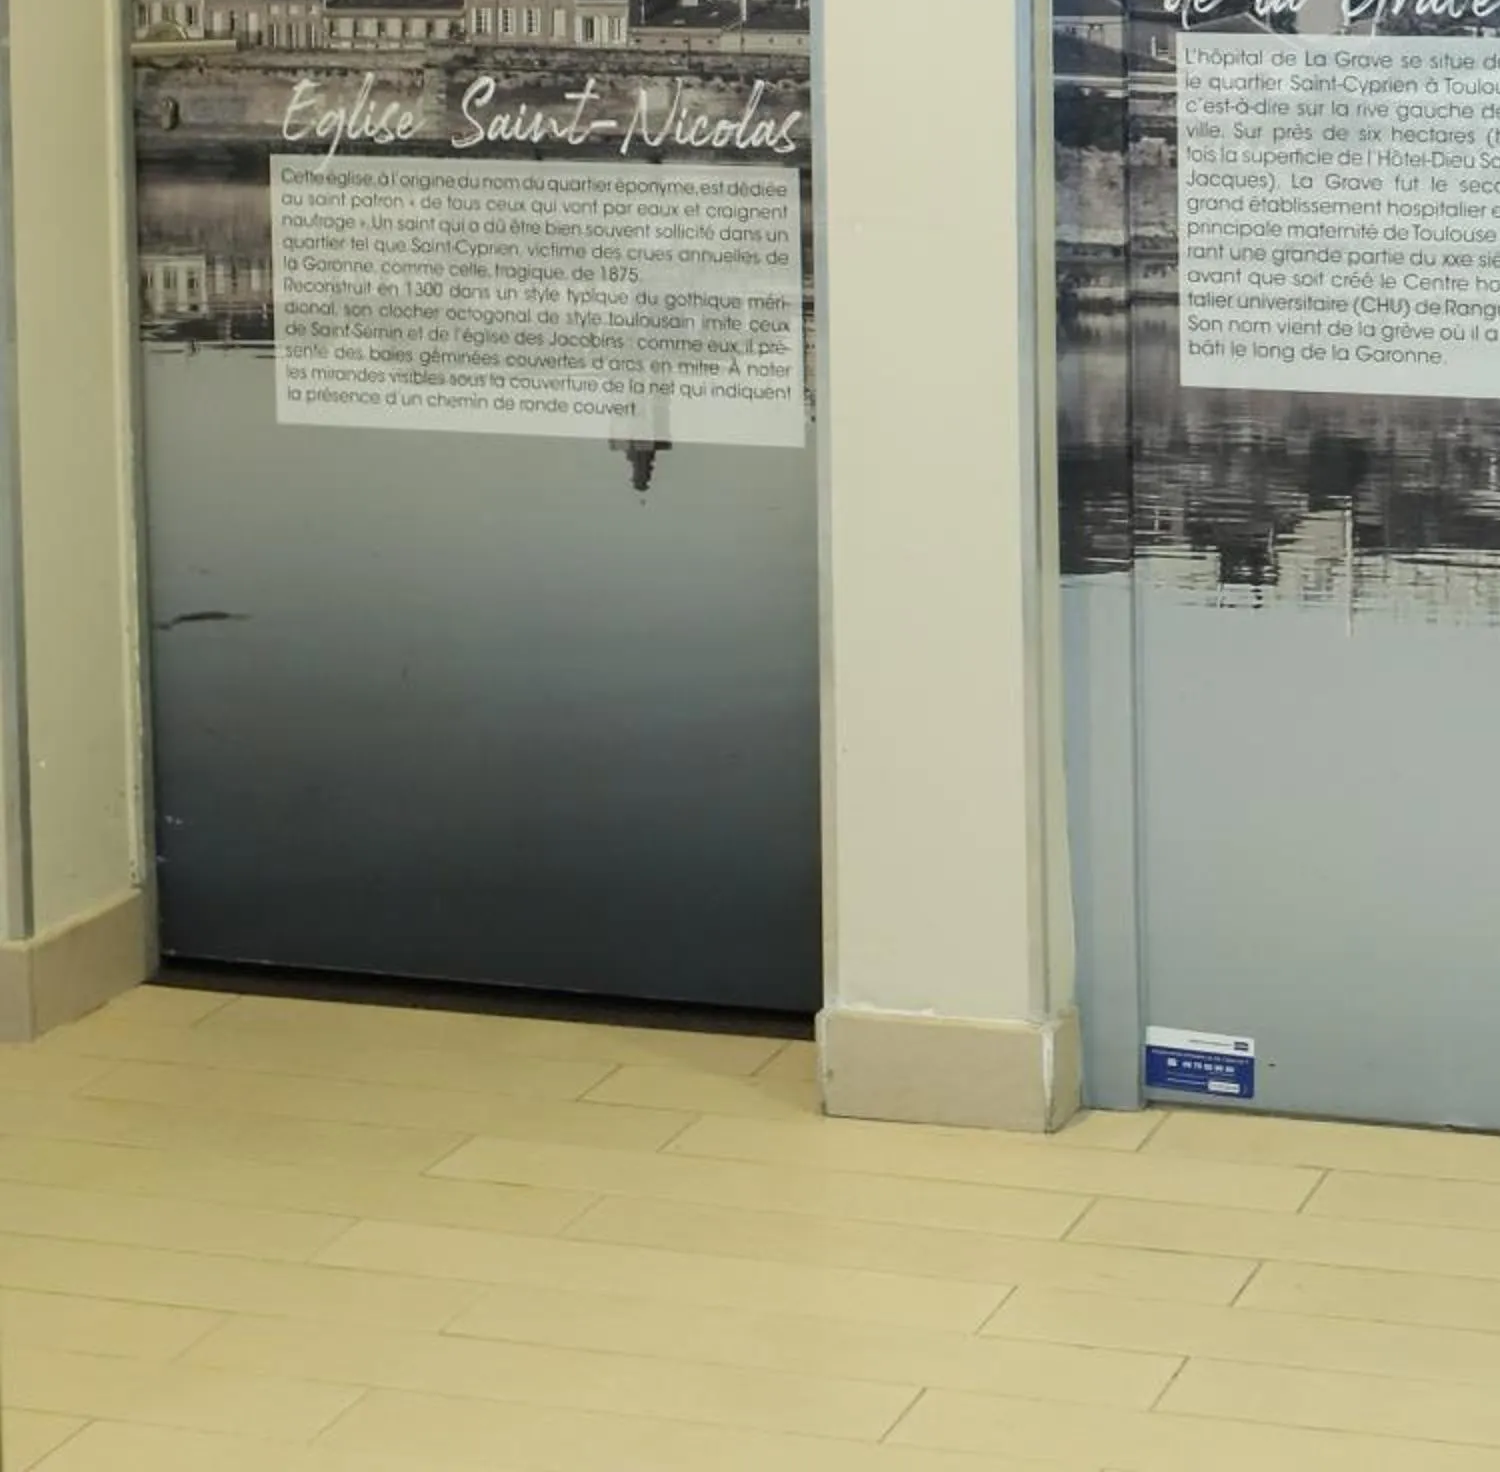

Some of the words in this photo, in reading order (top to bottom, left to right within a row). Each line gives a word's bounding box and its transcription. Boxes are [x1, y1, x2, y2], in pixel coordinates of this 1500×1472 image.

[1185, 48, 1263, 71] L'hôpital
[1271, 49, 1297, 67] de
[1305, 49, 1327, 67] La
[1335, 50, 1393, 68] Grave
[1400, 56, 1422, 69] se
[1429, 51, 1475, 69] situe
[1186, 72, 1201, 90] le
[1208, 73, 1282, 95] quartier
[1290, 74, 1418, 97] Saint-Cyprien
[1425, 76, 1439, 93] à
[451, 75, 802, 154] Saint-Nicolas
[1297, 104, 1324, 116] sur
[1332, 99, 1349, 117] la
[1356, 100, 1389, 118] rive
[1396, 100, 1474, 123] gauche
[1186, 121, 1224, 139] ville.
[1233, 122, 1262, 140] Sur
[1273, 123, 1313, 145] près
[1322, 124, 1349, 141] de
[1359, 124, 1382, 142] six
[1391, 125, 1475, 144] hectares
[1187, 146, 1217, 164] fois
[1221, 146, 1238, 164] la
[1242, 147, 1333, 170] superficie
[1337, 148, 1362, 166] de
[1292, 172, 1313, 189] La
[1325, 173, 1383, 191] Grave
[1395, 174, 1419, 192] fut
[1431, 175, 1448, 192] le
[281, 195, 303, 207] au
[308, 192, 346, 208] saint
[351, 193, 404, 213] patron
[420, 194, 442, 210] de
[447, 195, 481, 211] tous
[486, 200, 525, 212] ceux
[531, 197, 557, 217] qui
[563, 198, 597, 214] vont
[603, 203, 631, 219] par
[637, 204, 679, 216] eaux
[684, 201, 700, 217] et
[705, 202, 788, 222] craignent
[1187, 194, 1244, 217] grand
[1249, 195, 1382, 215] établissement
[1387, 198, 1486, 222] hospitalier
[396, 215, 435, 231] saint
[586, 221, 650, 238] souvent
[719, 225, 763, 242] dans
[766, 231, 789, 243] un
[1187, 218, 1282, 241] principale
[1288, 220, 1378, 240] maternité
[1383, 223, 1409, 240] de
[1412, 223, 1497, 243] Toulouse
[282, 233, 346, 253] quartier
[350, 235, 369, 251] tel
[374, 240, 407, 256] que
[527, 241, 587, 258] victime
[591, 243, 621, 259] des
[626, 248, 673, 261] crues
[765, 249, 789, 265] de
[1187, 242, 1224, 260] rant
[1229, 248, 1266, 261] une
[1272, 244, 1342, 267] grande
[1347, 246, 1405, 269] partie
[1409, 248, 1436, 266] du
[380, 263, 444, 276] comme
[571, 265, 595, 281] de
[1187, 266, 1242, 285] avant
[1247, 273, 1286, 290] que
[1292, 269, 1324, 287] soit
[1331, 270, 1374, 289] créé
[1380, 272, 1397, 289] le
[1403, 272, 1469, 292] Centre
[407, 282, 443, 299] 1300
[635, 290, 659, 306] du
[664, 291, 742, 311] gothique
[1187, 291, 1233, 309] talier
[1237, 292, 1348, 312] universitaire
[1353, 295, 1411, 318] (CHU)
[1415, 297, 1441, 314] de
[549, 330, 625, 347] Jacobins
[1187, 314, 1223, 332] Son
[1228, 321, 1271, 334] nom
[1277, 317, 1322, 336] vient
[1327, 319, 1353, 337] de
[1358, 320, 1375, 337] la
[1381, 321, 1435, 344] grève
[1439, 323, 1465, 340] où
[1471, 323, 1479, 341] il
[1484, 329, 1498, 342] a
[1188, 338, 1225, 356] bâti
[1231, 339, 1247, 357] le
[1253, 340, 1295, 363] long
[1300, 342, 1326, 360] de
[1332, 343, 1349, 361] la
[311, 365, 385, 383] mirandes
[710, 382, 791, 403] indiquent
[306, 386, 381, 407] présence
[427, 391, 488, 409] chemin
[519, 395, 569, 412] ronde
